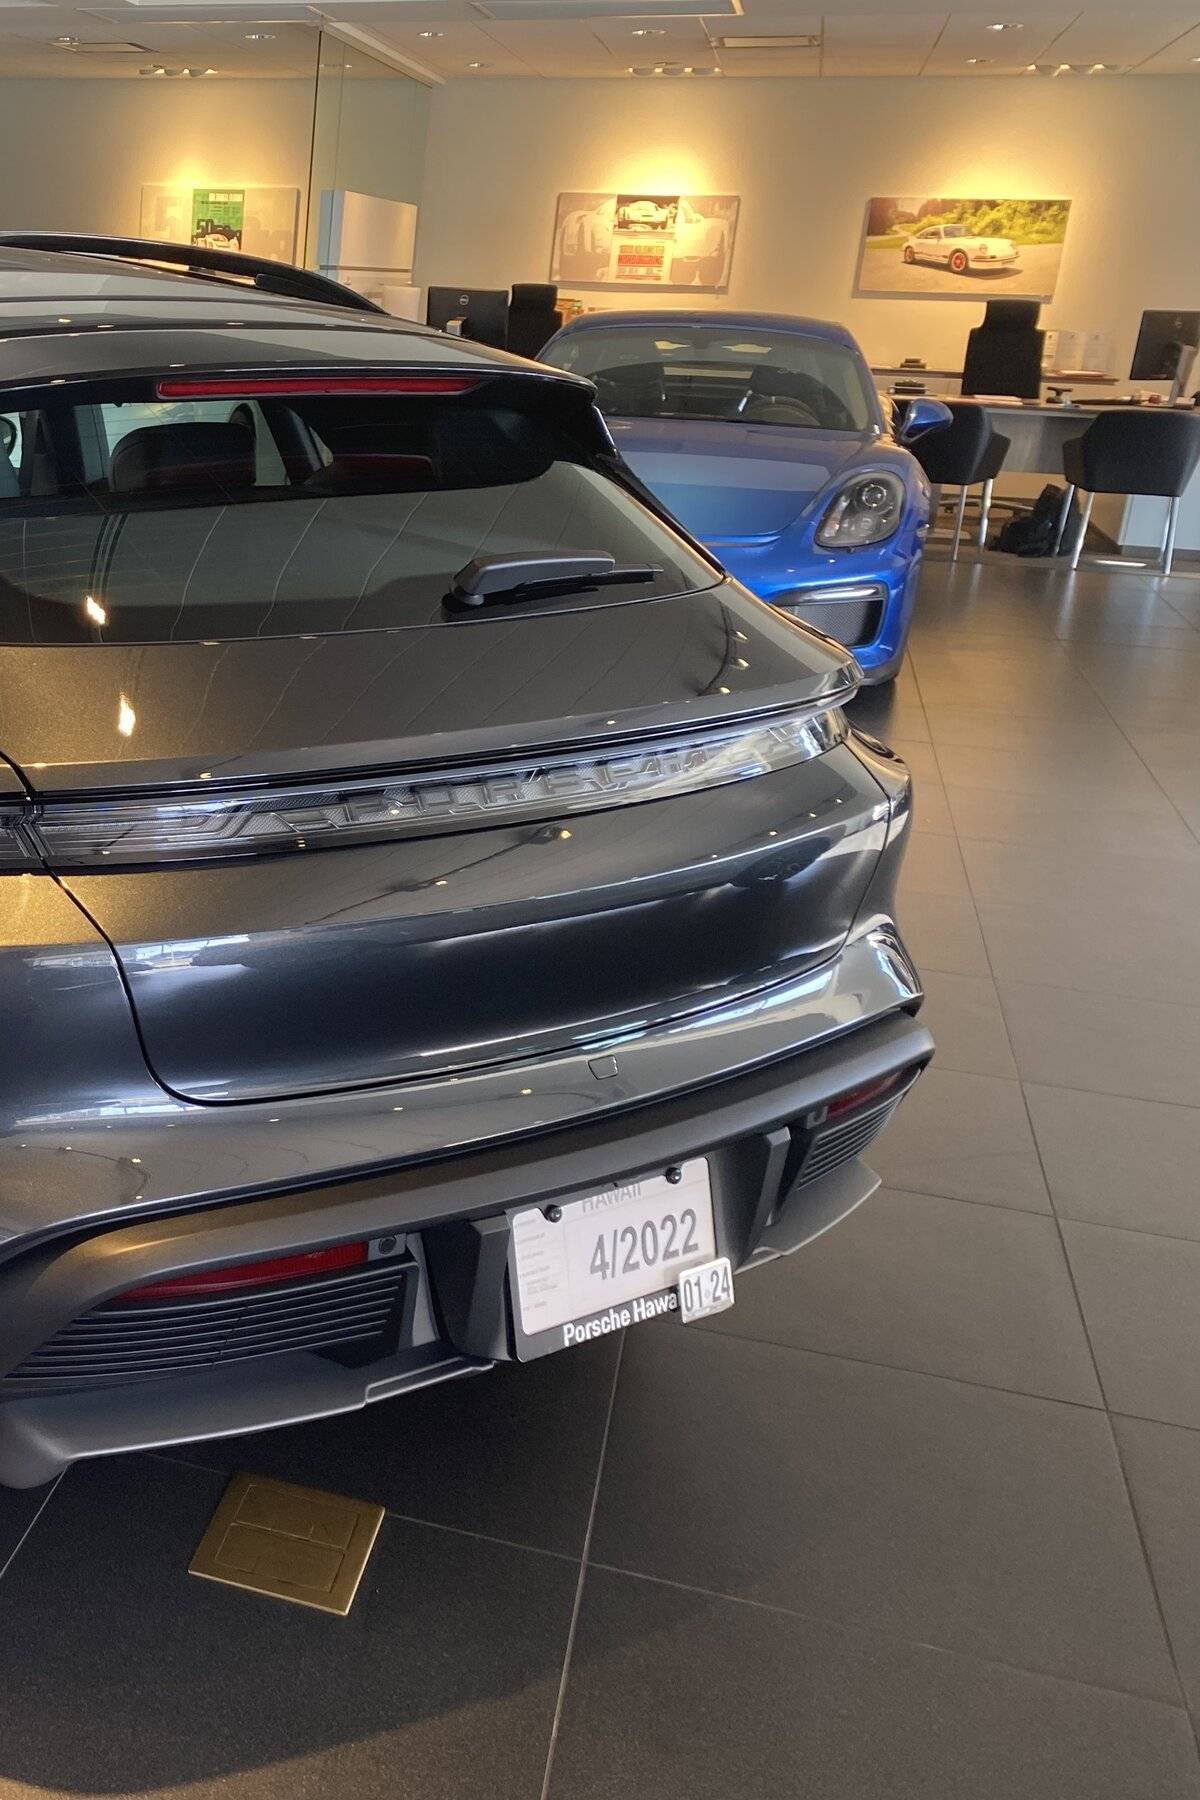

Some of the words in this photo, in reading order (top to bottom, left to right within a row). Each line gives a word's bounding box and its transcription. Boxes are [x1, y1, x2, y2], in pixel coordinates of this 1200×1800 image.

[590, 1208, 699, 1280] 4/2022
[710, 1266, 731, 1303] 24
[563, 1309, 632, 1347] Porsche
[633, 1292, 678, 1320] Hawa
